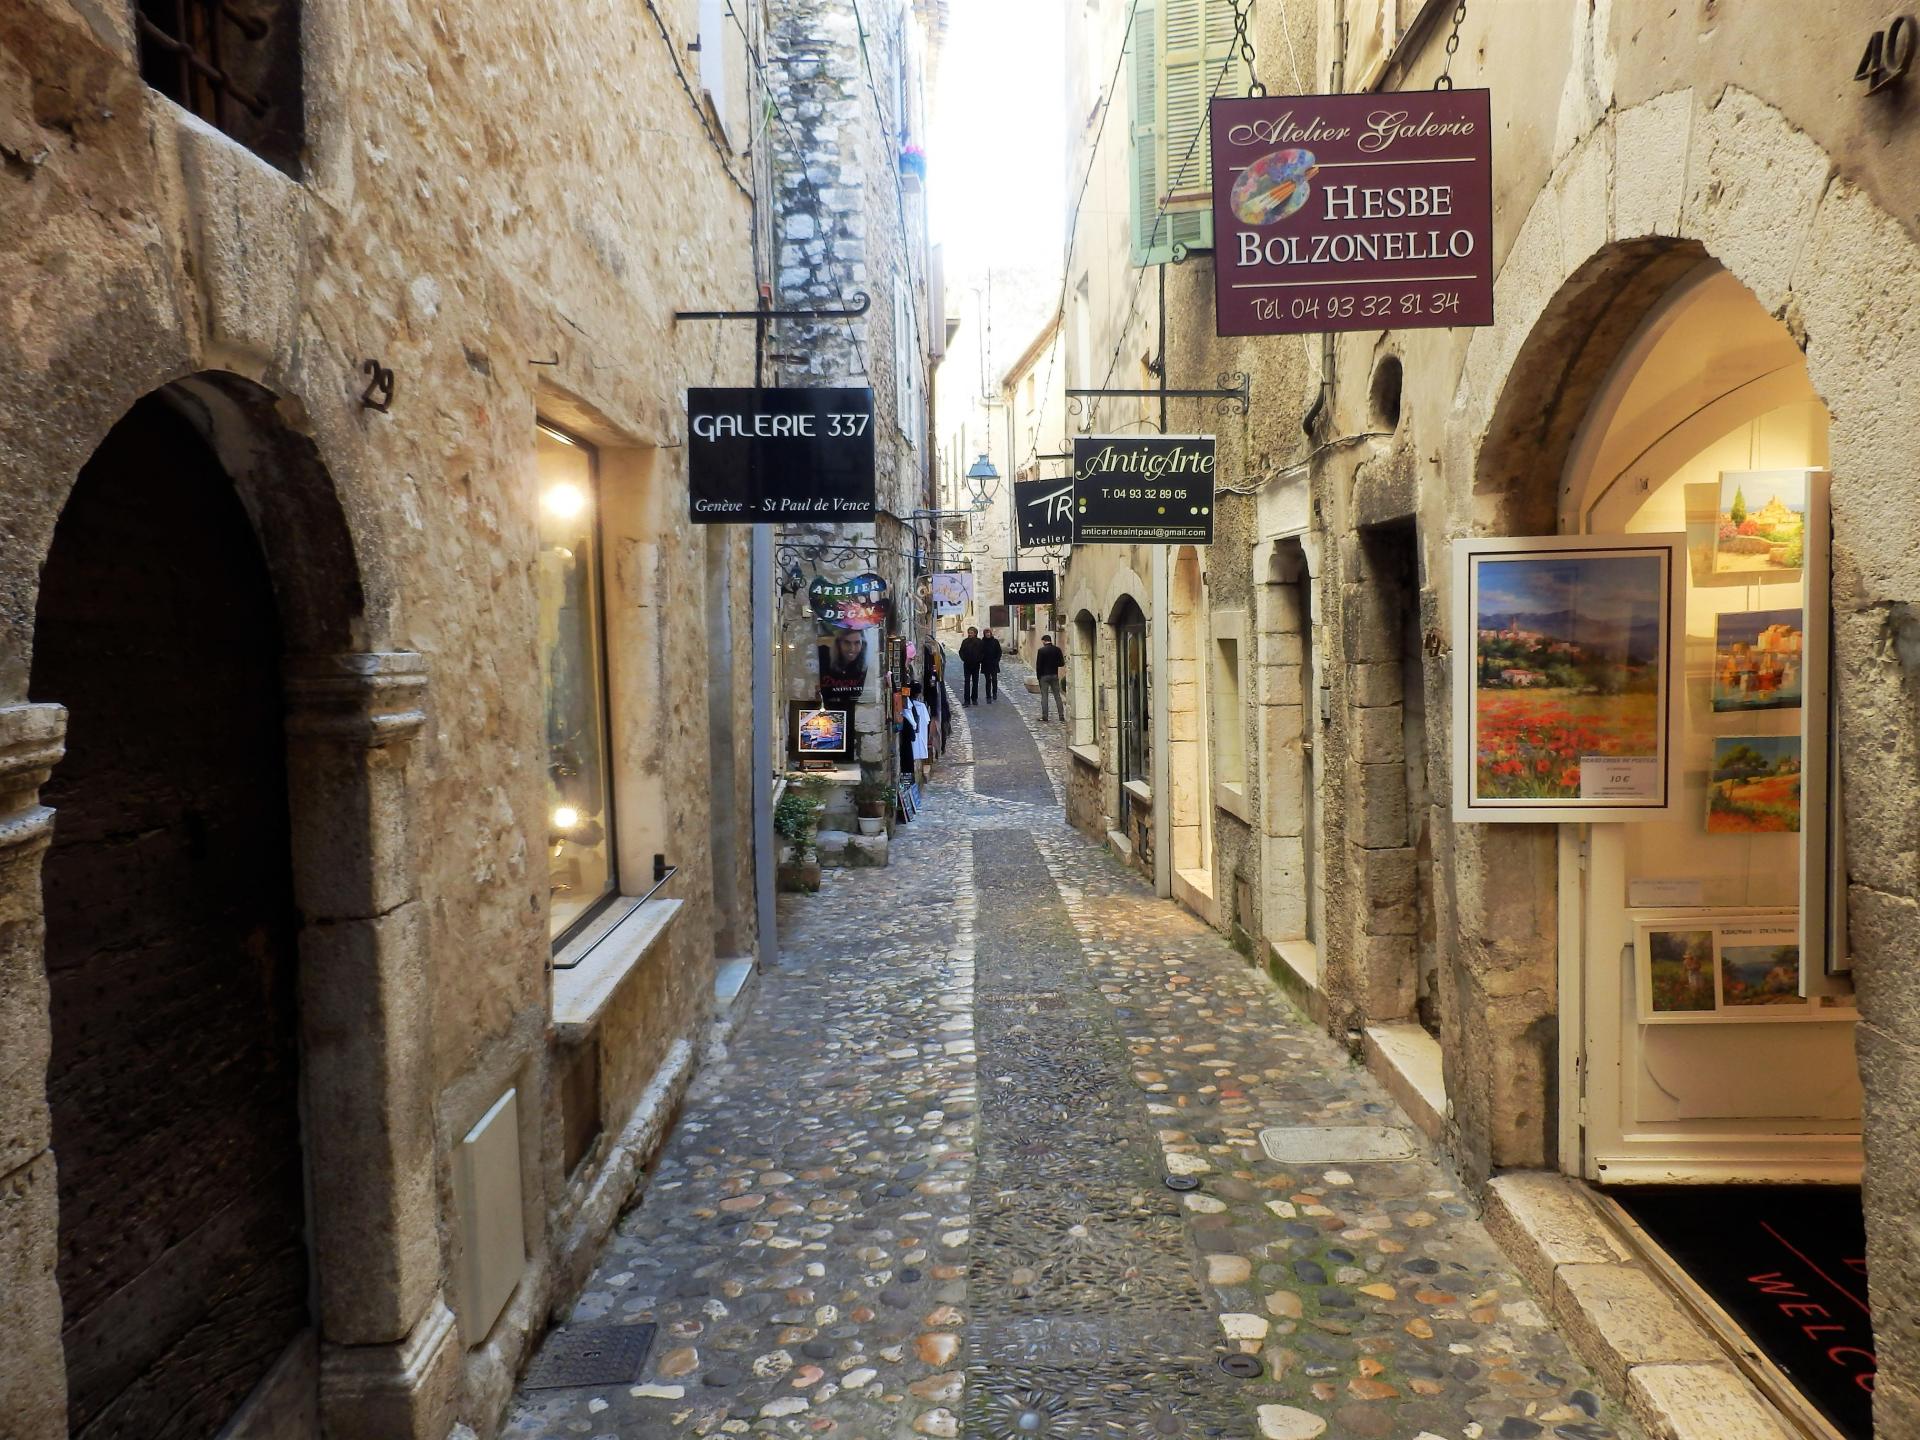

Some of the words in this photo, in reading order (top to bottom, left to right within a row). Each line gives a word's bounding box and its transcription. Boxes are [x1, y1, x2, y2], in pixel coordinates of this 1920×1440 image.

[1854, 15, 1918, 94] 40
[1228, 110, 1350, 146] Atelier
[1357, 109, 1475, 153] Galerie
[1322, 185, 1452, 221] HESBE
[1236, 229, 1475, 267] BOLZONELLO
[1251, 298, 1284, 321] Tél.
[1291, 298, 1320, 319] 04
[1327, 295, 1355, 319] 93
[1360, 295, 1392, 317] 32
[1399, 293, 1422, 315] 81
[1429, 292, 1460, 314] 34
[693, 414, 817, 442] GALERIE
[827, 414, 870, 437] 337
[695, 499, 743, 512] Genève
[762, 498, 776, 512] St
[780, 498, 811, 512] Paul
[814, 499, 829, 512] de
[834, 498, 870, 512] Vence
[1102, 488, 1111, 499] T.
[1114, 489, 1126, 498] 04
[1130, 489, 1142, 499] 93
[1145, 489, 1157, 499] 32
[1160, 489, 1172, 499] 89
[1175, 489, 1187, 499] 05
[1029, 535, 1066, 545] Atelier
[1081, 527, 1206, 537] anticartesaintpaul@gmail.com
[813, 580, 879, 595] ATELIER
